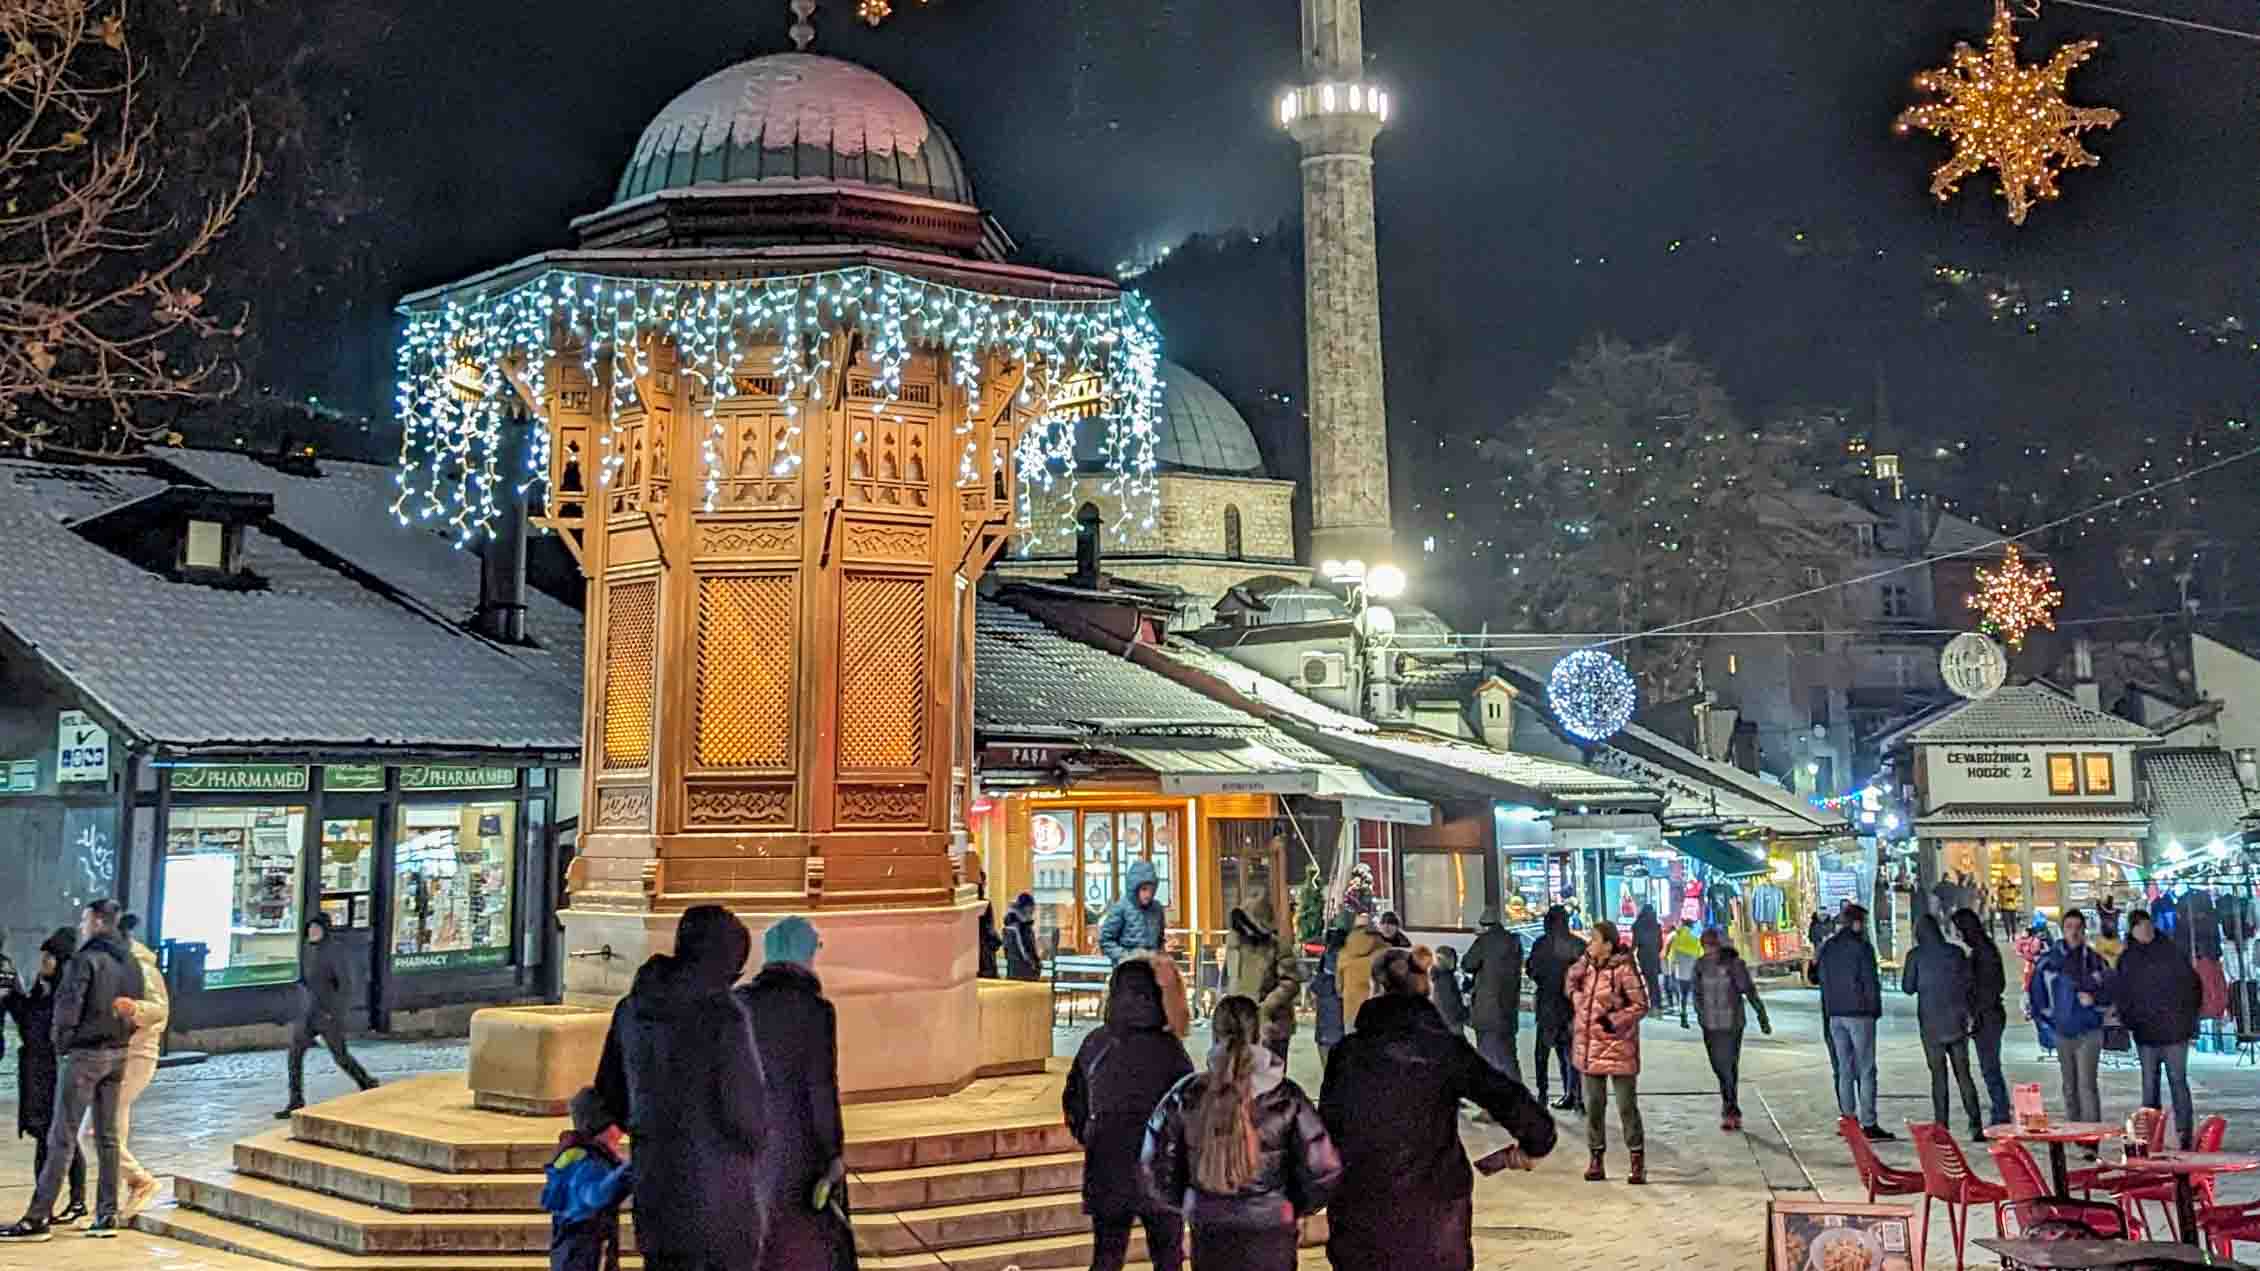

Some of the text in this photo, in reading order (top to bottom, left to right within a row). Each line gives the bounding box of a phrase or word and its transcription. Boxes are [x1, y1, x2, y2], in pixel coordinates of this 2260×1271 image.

[207, 770, 305, 788] PHARMAMED
[430, 769, 513, 785] PHARMAMED
[394, 954, 447, 969] PHARMACY
